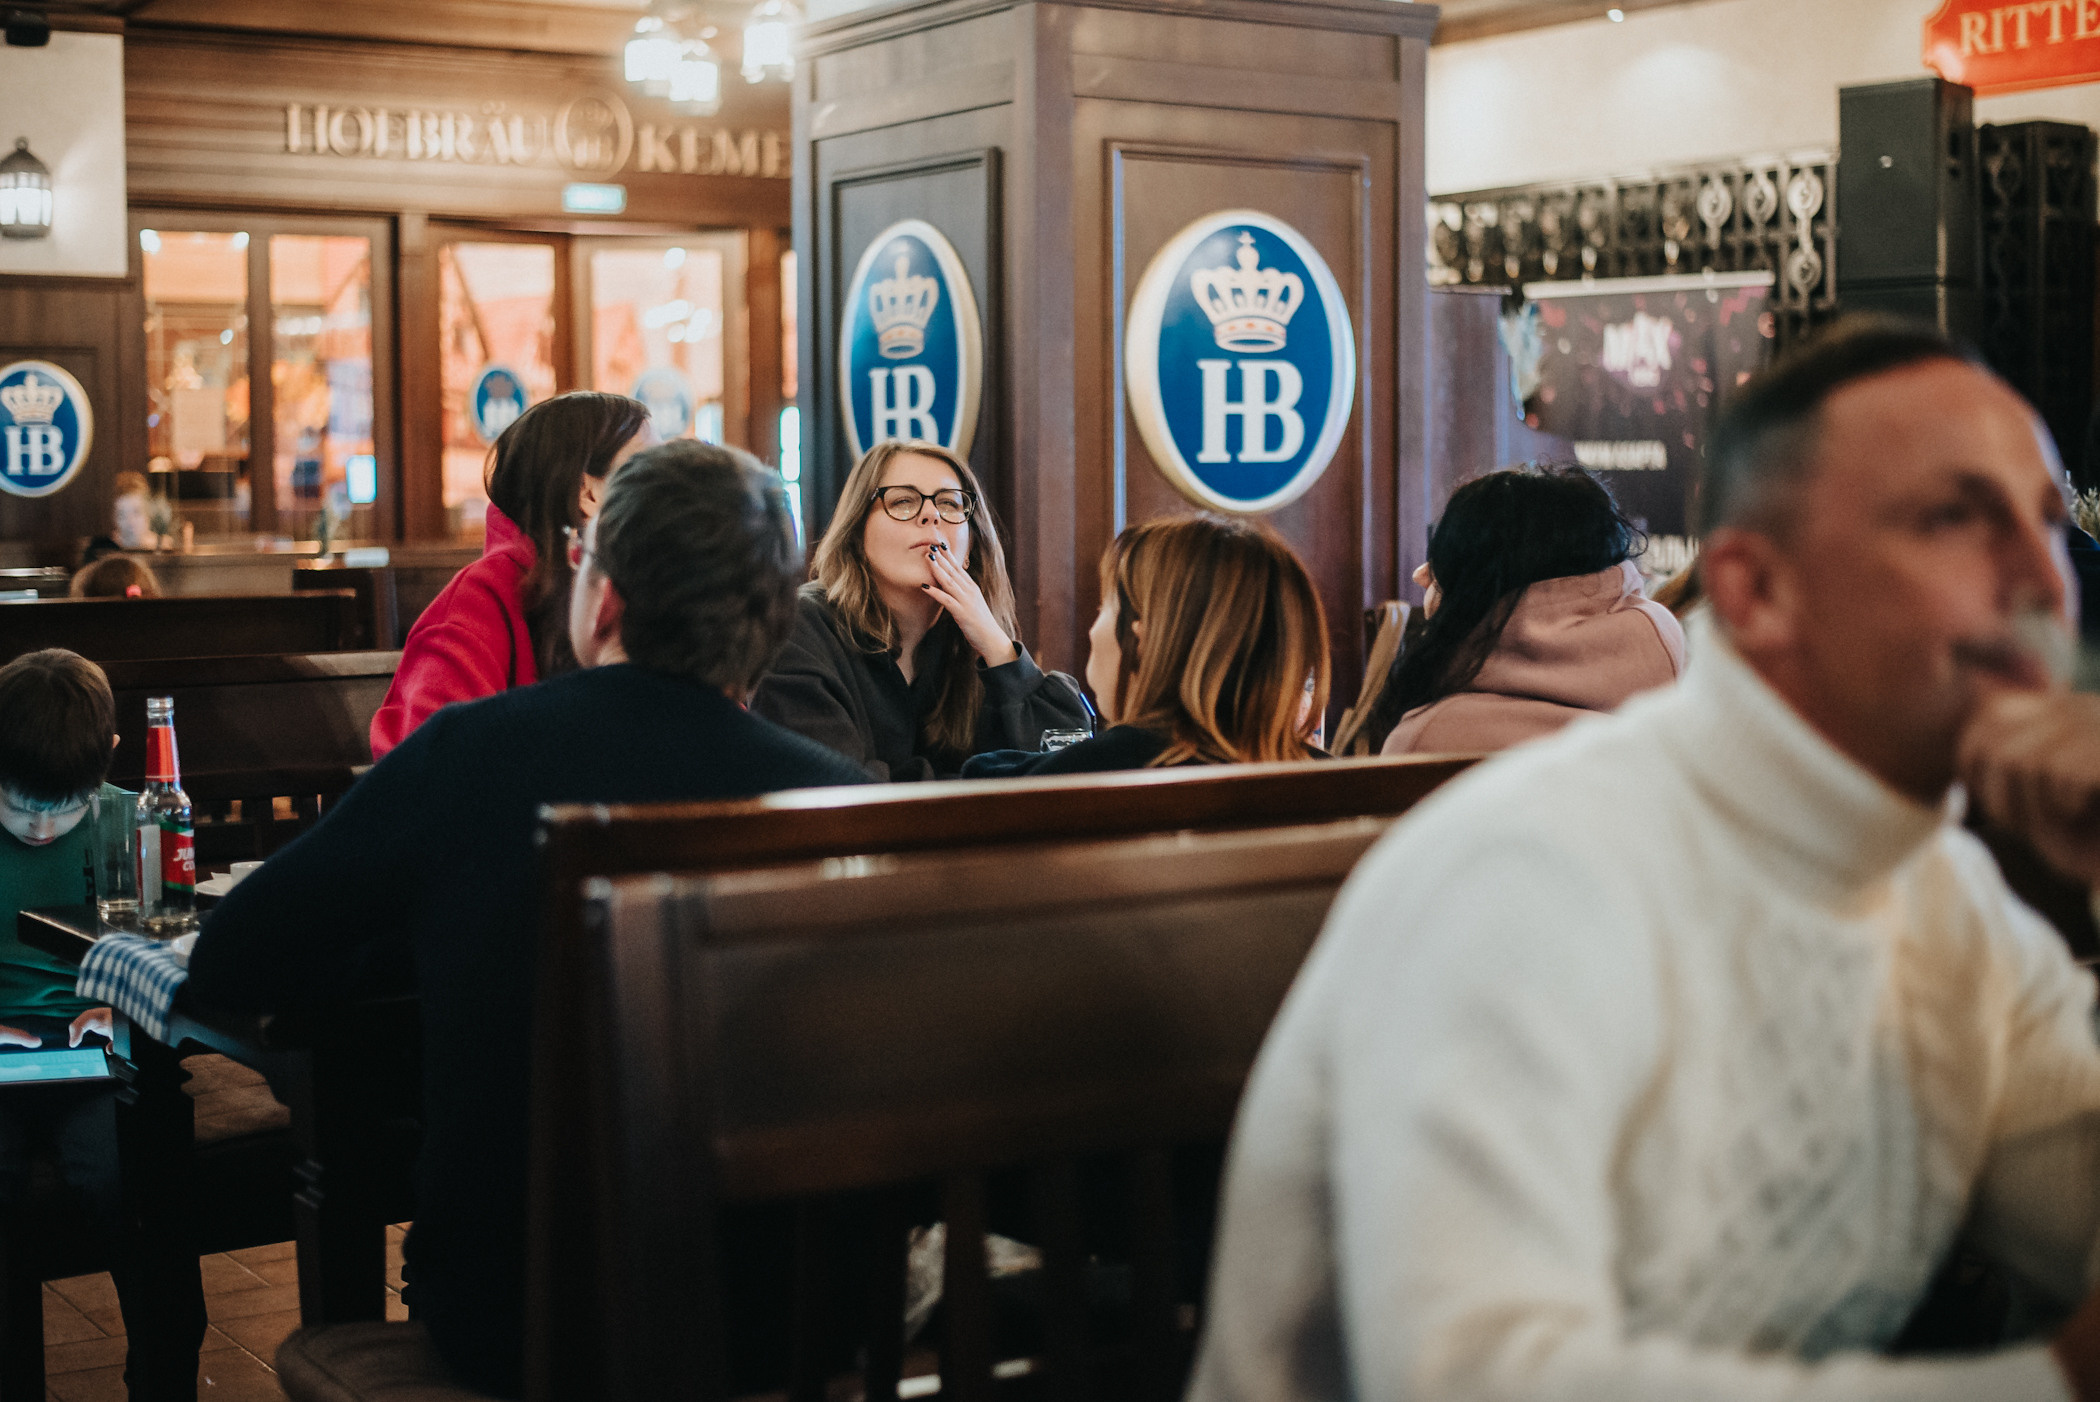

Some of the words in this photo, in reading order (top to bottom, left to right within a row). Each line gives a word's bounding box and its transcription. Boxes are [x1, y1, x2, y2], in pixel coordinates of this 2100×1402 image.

[283, 101, 548, 166] HOFBRÄU
[868, 364, 940, 447] HB
[1195, 358, 1306, 464] HB
[4, 425, 66, 476] HB
